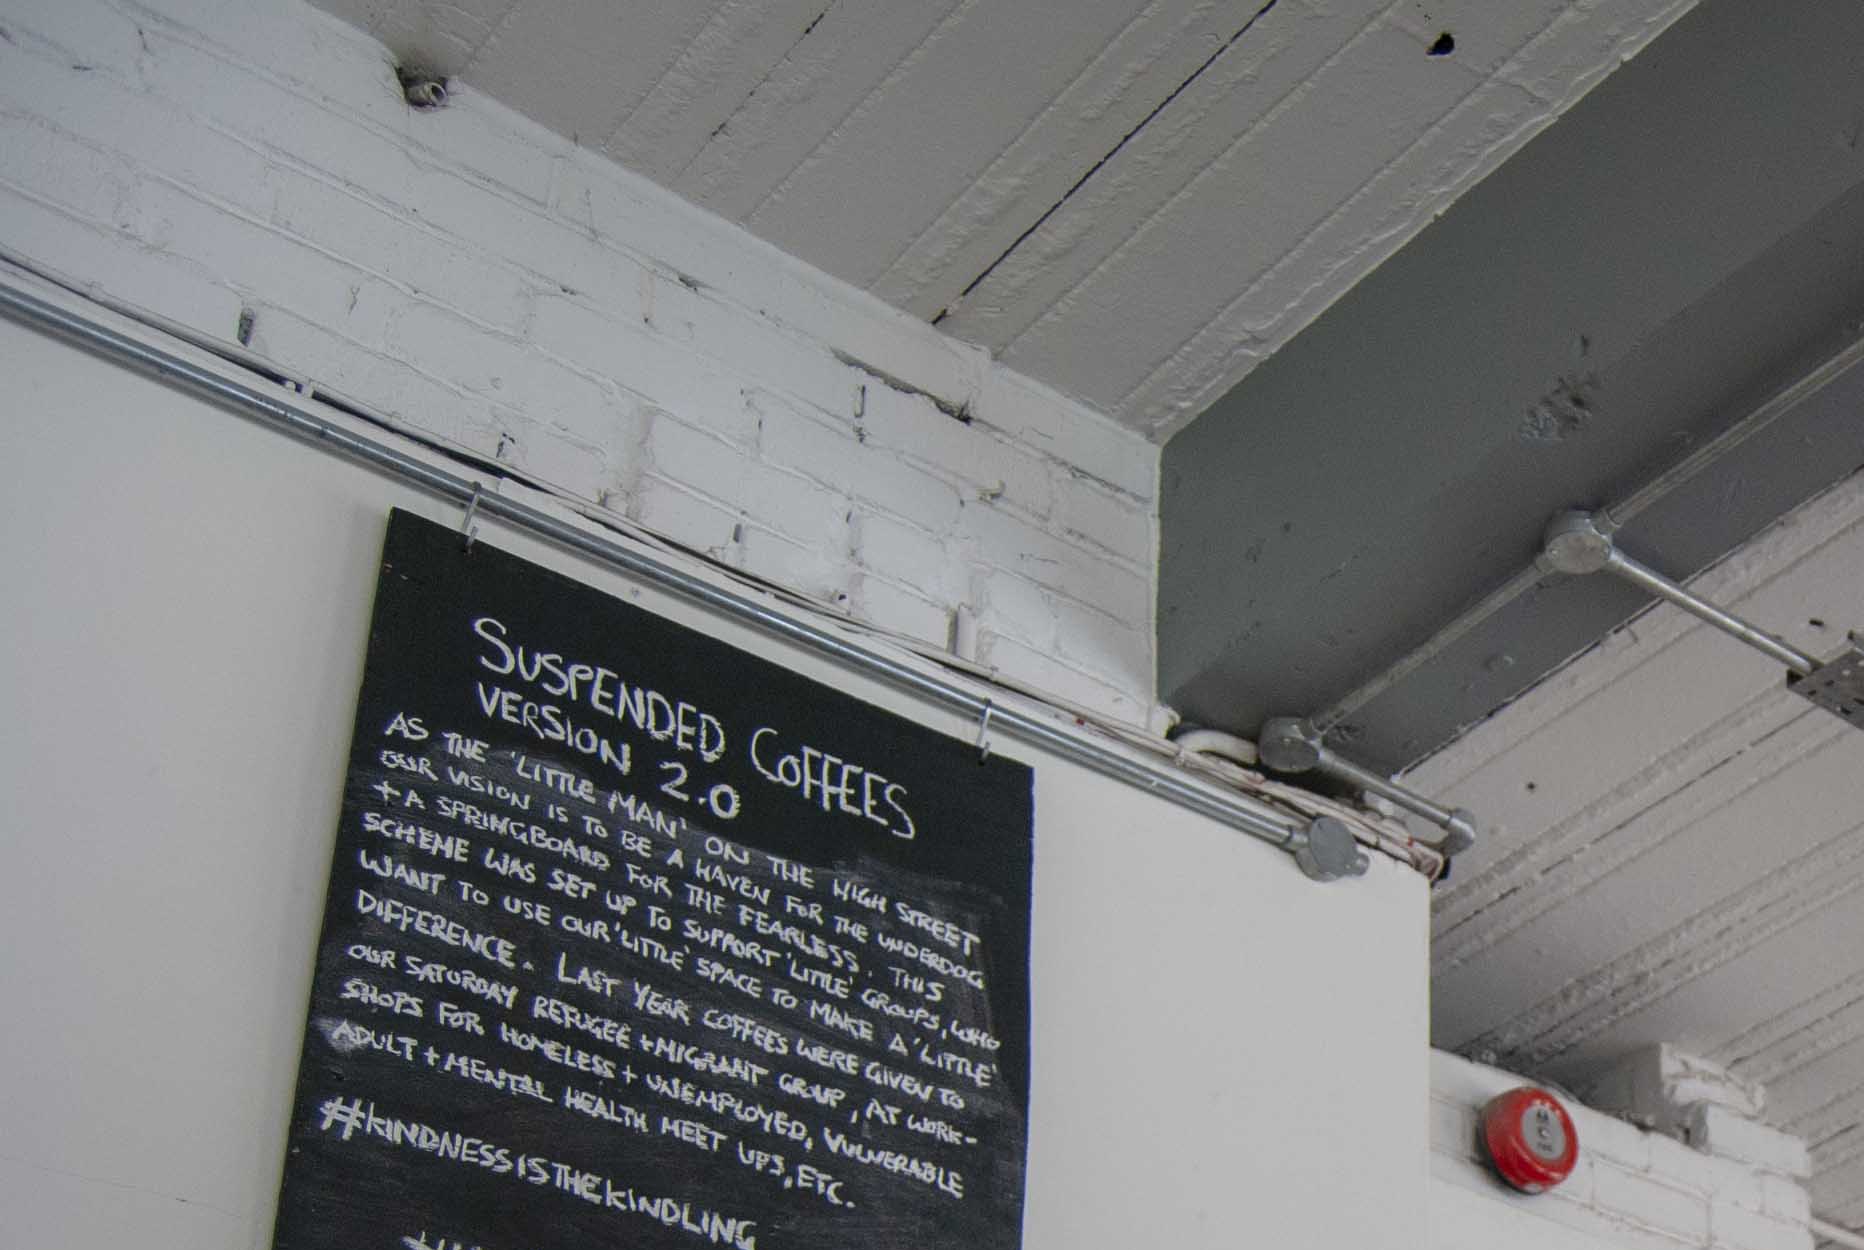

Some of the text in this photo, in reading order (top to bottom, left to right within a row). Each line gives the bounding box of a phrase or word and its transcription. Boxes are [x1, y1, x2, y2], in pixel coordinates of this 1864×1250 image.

[474, 617, 916, 840] SUSPENDED COFFEES
[478, 682, 742, 820] VERSION 2.0
[363, 811, 471, 863] SCHEME
[485, 847, 537, 883] WAS
[547, 868, 598, 900] SET
[606, 889, 638, 916] UP
[648, 904, 672, 931] TO
[683, 919, 782, 967] SUPPORT
[380, 750, 985, 990] OUR VISION IS TO BE A HAVEN FOR THE UNDERDOG
[385, 711, 430, 741] AS
[441, 731, 490, 763] THE
[704, 836, 750, 865] ON
[766, 855, 815, 889] THE
[833, 878, 887, 914] HIGH
[896, 901, 981, 956] STREET
[404, 789, 427, 810] A
[436, 796, 611, 872] SPRINGBOARD
[626, 863, 673, 898] FOR
[684, 882, 727, 914] THE
[888, 966, 945, 1001] THIS
[347, 944, 397, 969] OUR
[404, 955, 520, 1011] SATURDAY
[533, 995, 632, 1050] REFUGEE
[865, 1097, 902, 1126] AT
[359, 849, 446, 896] WANT
[458, 880, 490, 905] TO
[503, 894, 550, 926] USE
[561, 914, 612, 943] OUR
[696, 957, 763, 998] SPACE
[771, 987, 799, 1009] TO
[809, 999, 875, 1042] MAKE
[888, 1033, 909, 1057] A
[557, 951, 623, 998] LAST
[633, 976, 691, 1027] YEAR
[703, 1009, 789, 1056] COFFEES
[796, 1038, 859, 1076] WERE
[865, 1061, 934, 1101] GIVEN
[937, 1087, 965, 1110] TO
[330, 1018, 419, 1061] ADULT
[444, 1052, 553, 1103] MENTAL
[565, 1086, 649, 1132] HEALTH
[662, 1116, 729, 1151] MEET
[339, 978, 424, 1018] SHOPS
[439, 1001, 486, 1036] FOR
[500, 1021, 617, 1079] HOMELESS
[823, 1126, 964, 1199] VULNERABLE
